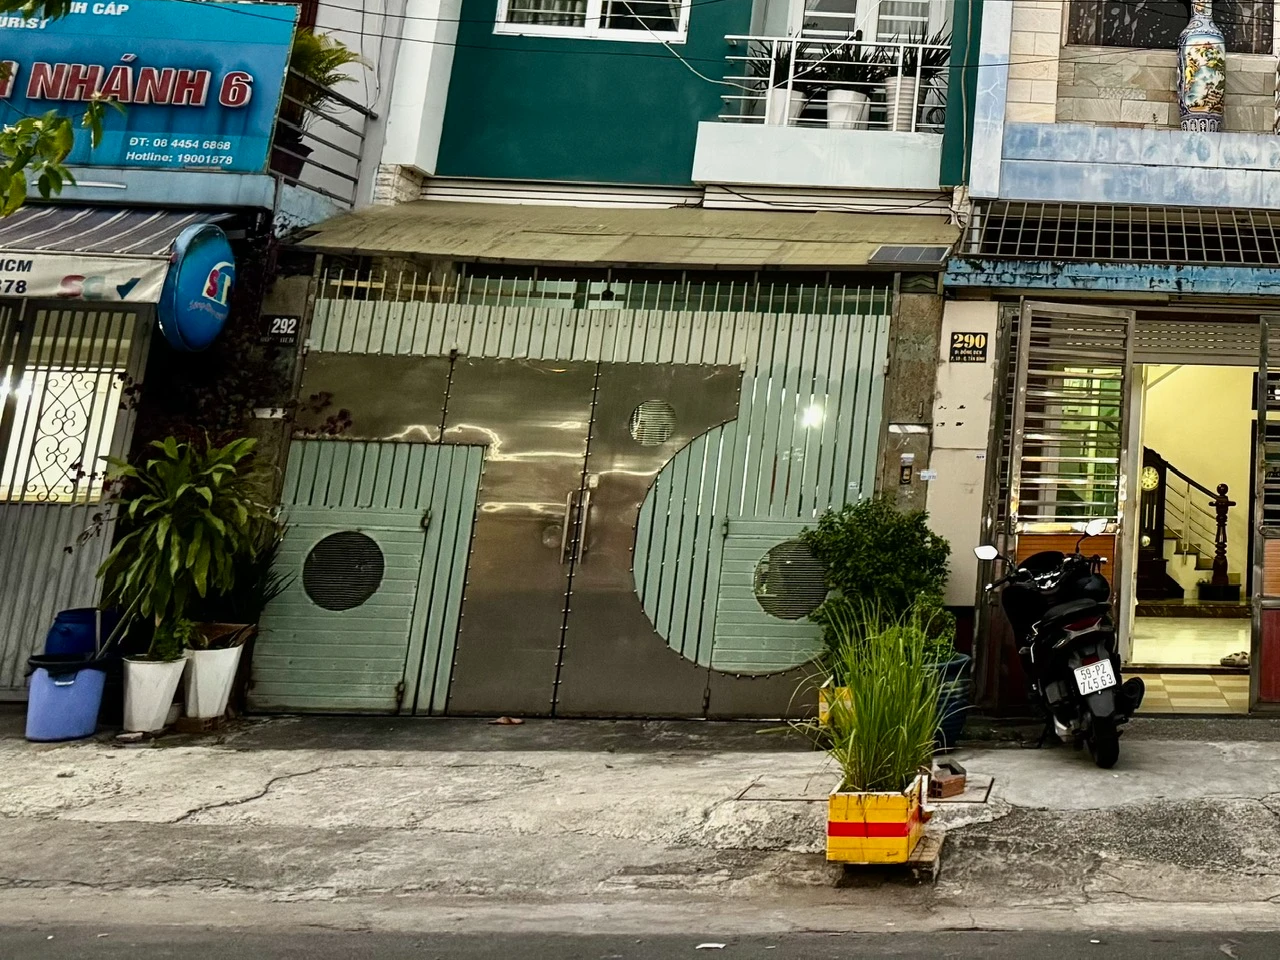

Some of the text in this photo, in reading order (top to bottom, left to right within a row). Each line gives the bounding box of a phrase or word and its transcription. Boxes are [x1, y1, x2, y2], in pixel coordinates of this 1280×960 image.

[92, 1, 130, 16] CÁP
[26, 53, 211, 107] NHÁNH
[218, 70, 254, 108] 6
[129, 136, 231, 151] ĐT: 08 4454 6868
[125, 151, 233, 165] Hotline: 19001878
[271, 318, 297, 334] 292
[952, 333, 986, 349] 290
[1080, 663, 1107, 681] 59-P2
[1080, 674, 1114, 694] 745.63
